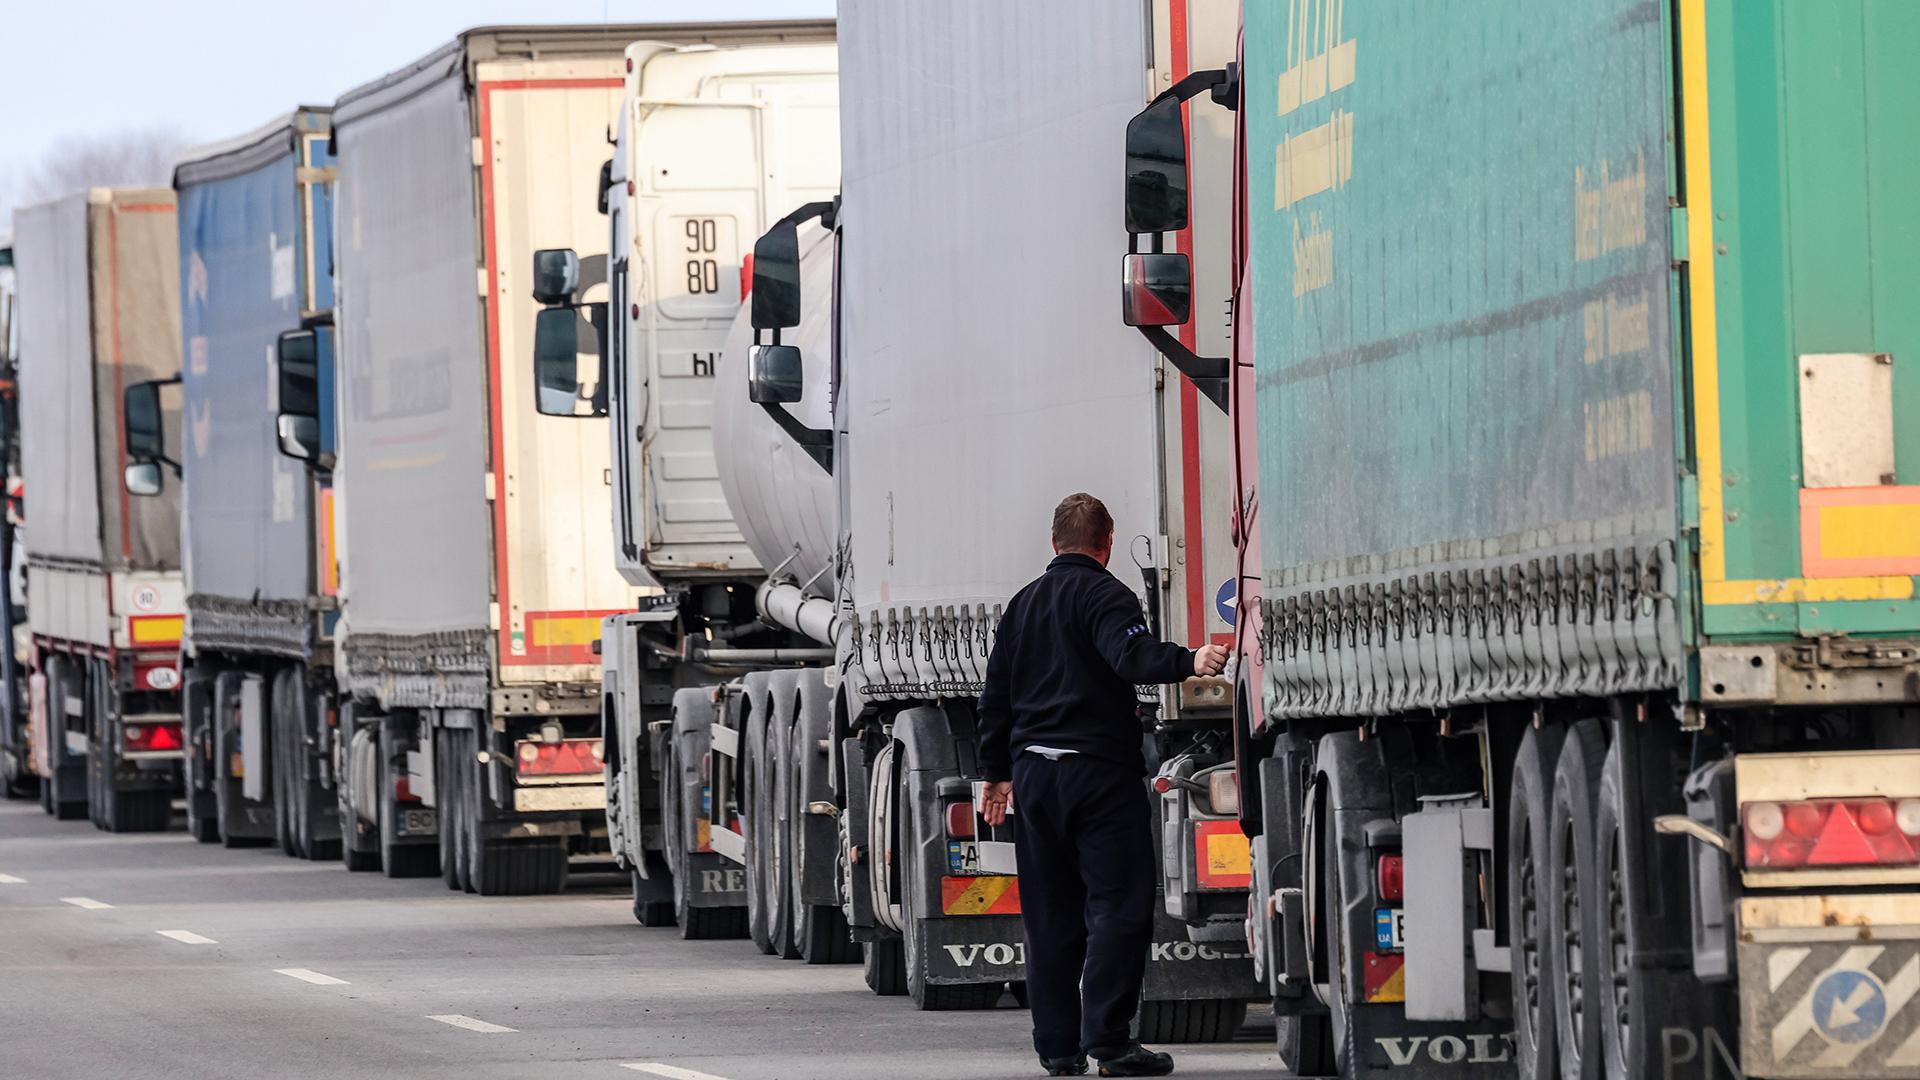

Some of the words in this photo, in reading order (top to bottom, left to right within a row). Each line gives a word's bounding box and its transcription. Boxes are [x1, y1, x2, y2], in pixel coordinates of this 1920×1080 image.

[686, 219, 716, 253] 90
[687, 259, 719, 294] 80
[965, 845, 978, 867] A
[1378, 933, 1392, 943] UA
[1151, 940, 1255, 961] KÖG
